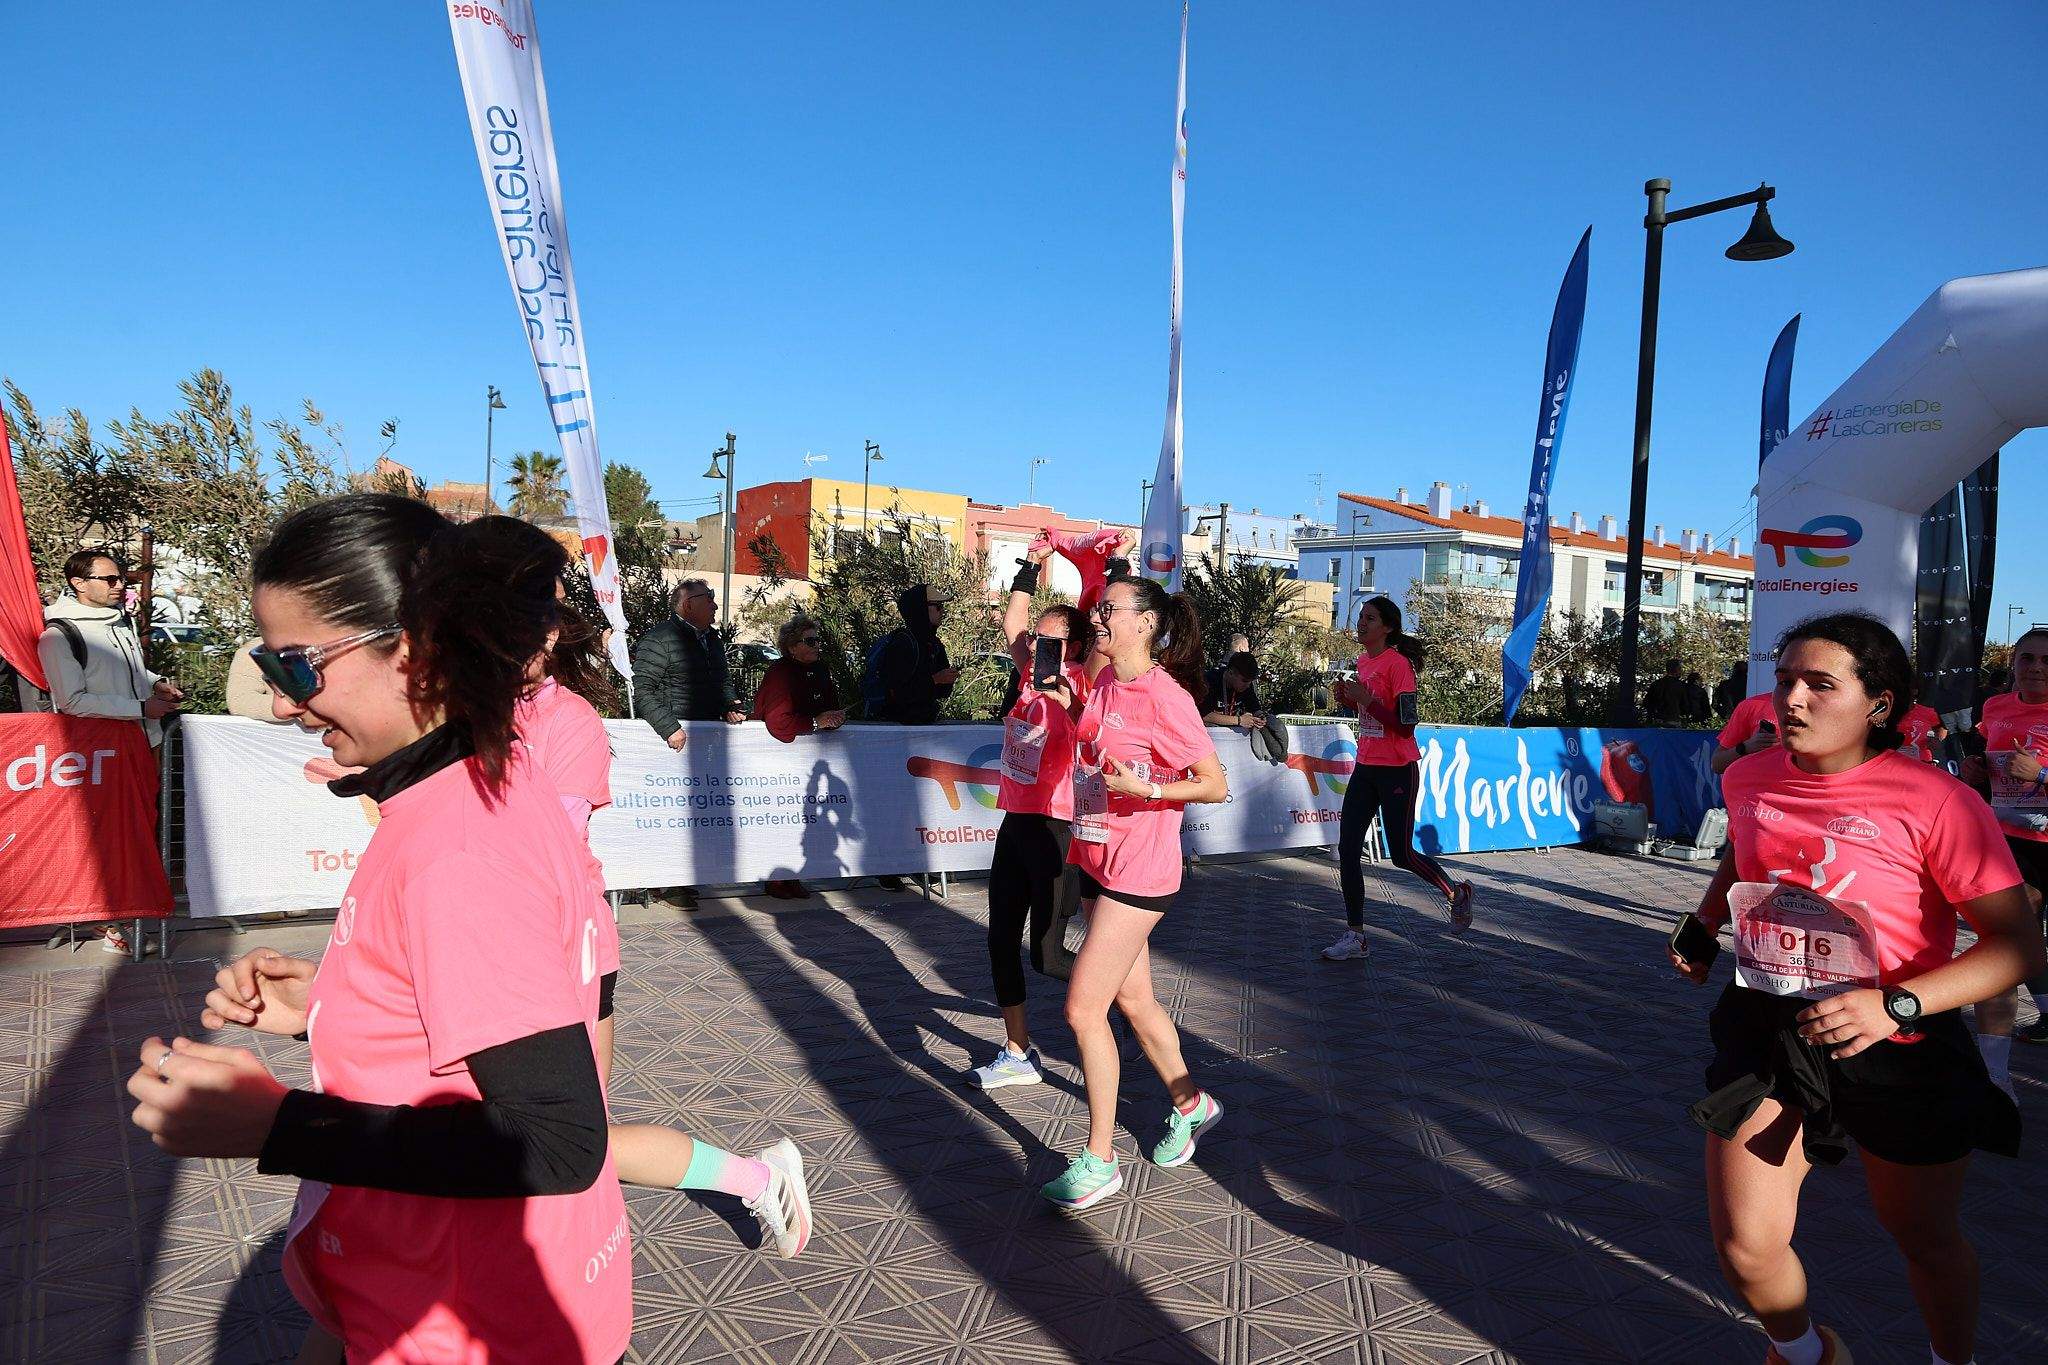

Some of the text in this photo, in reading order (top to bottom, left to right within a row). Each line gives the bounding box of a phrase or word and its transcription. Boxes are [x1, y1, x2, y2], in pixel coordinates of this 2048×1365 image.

[1832, 419, 1942, 438] LasCarreras
[1757, 579, 1859, 595] TotalEnergies
[644, 774, 701, 787] Somos
[706, 774, 719, 786] la
[611, 791, 847, 809] ultienergías que patrocina
[1415, 736, 1594, 852] Marlene
[635, 811, 817, 829] tus carreras preferidas
[1737, 805, 1784, 822] OYSHO
[1776, 899, 1826, 914] ASTURIANA
[1779, 931, 1832, 957] 016
[1779, 966, 1788, 974] DE
[1789, 967, 1798, 975] LA
[1789, 956, 1815, 968] 3673
[1751, 973, 1790, 990] OYSHO
